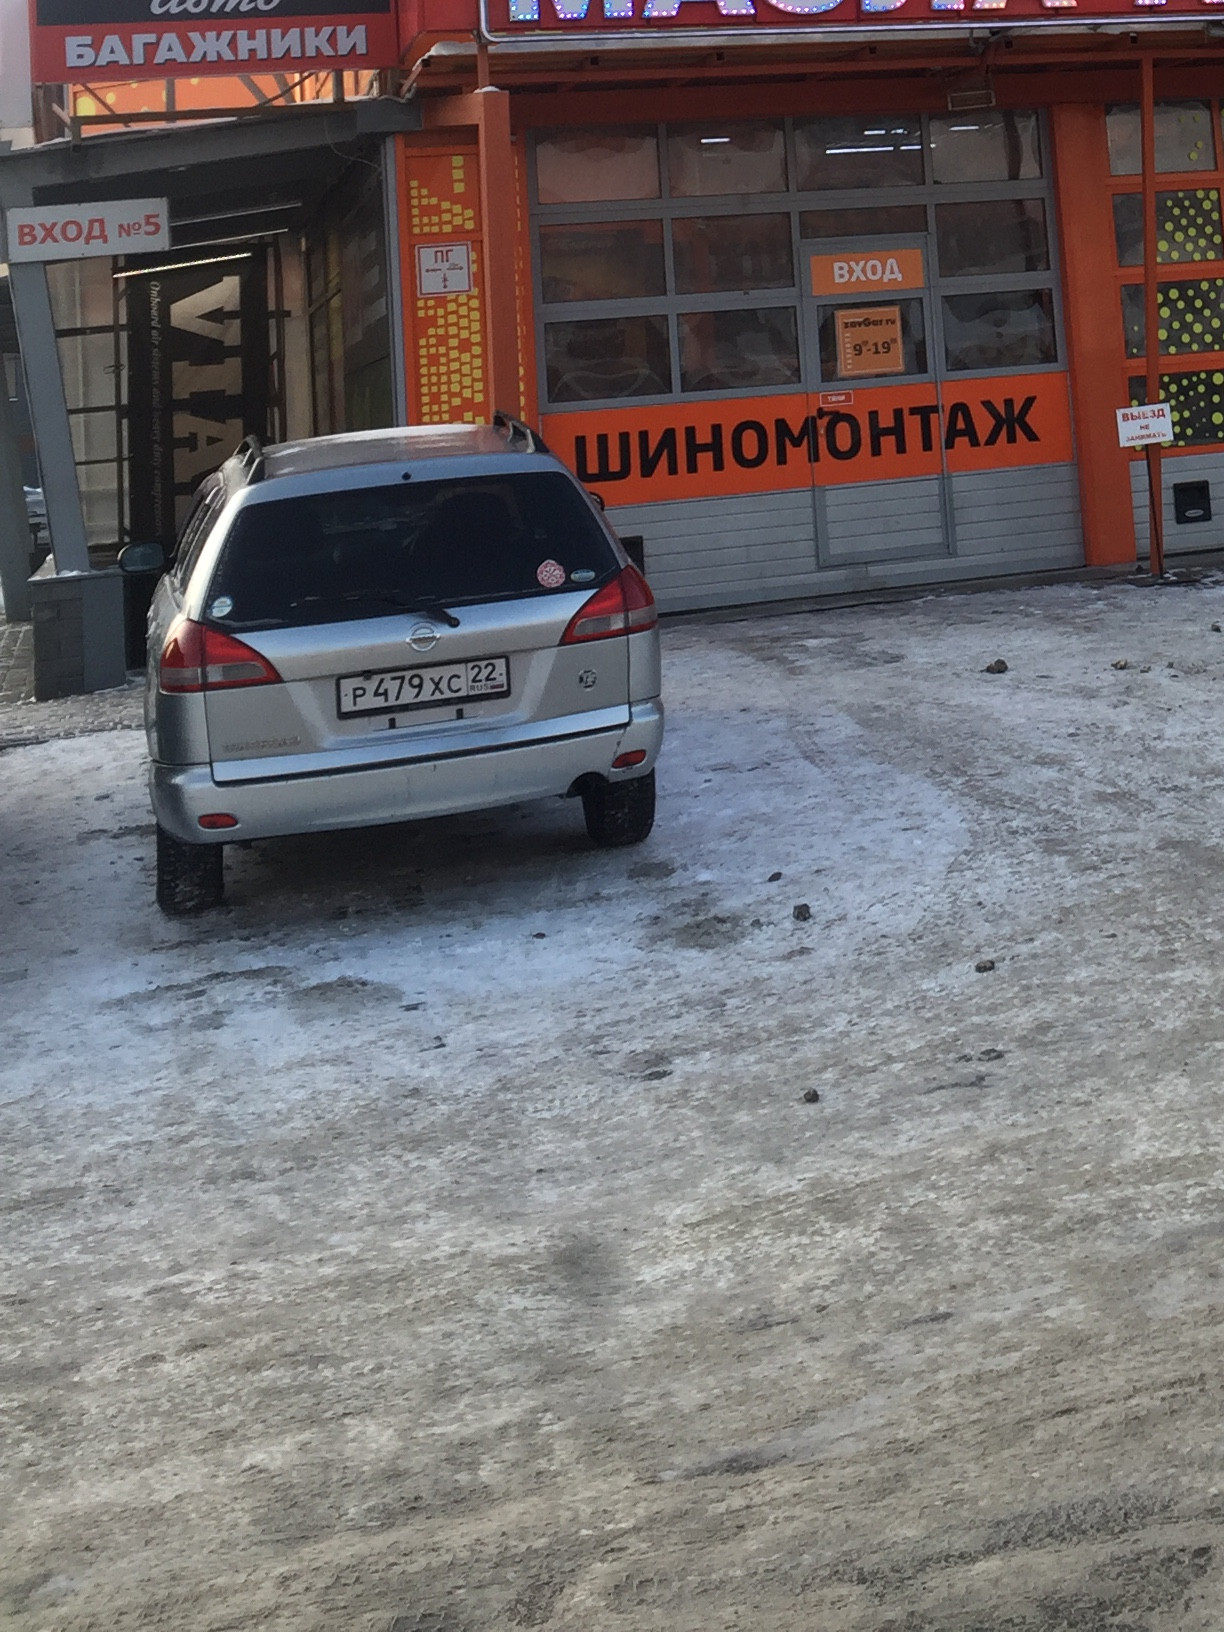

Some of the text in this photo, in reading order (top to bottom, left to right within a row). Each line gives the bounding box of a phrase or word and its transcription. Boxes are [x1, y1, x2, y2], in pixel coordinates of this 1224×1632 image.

[65, 25, 369, 69] БАГАЖНИКИ
[17, 217, 109, 246] ВХОД
[434, 248, 454, 264] ПГ
[833, 257, 903, 284] ВХОД
[169, 275, 244, 544] VIA
[1121, 408, 1167, 423] ВЫЕЗД
[574, 395, 1041, 483] ШИНОМОНТАЖ
[469, 683, 490, 693] RUS
